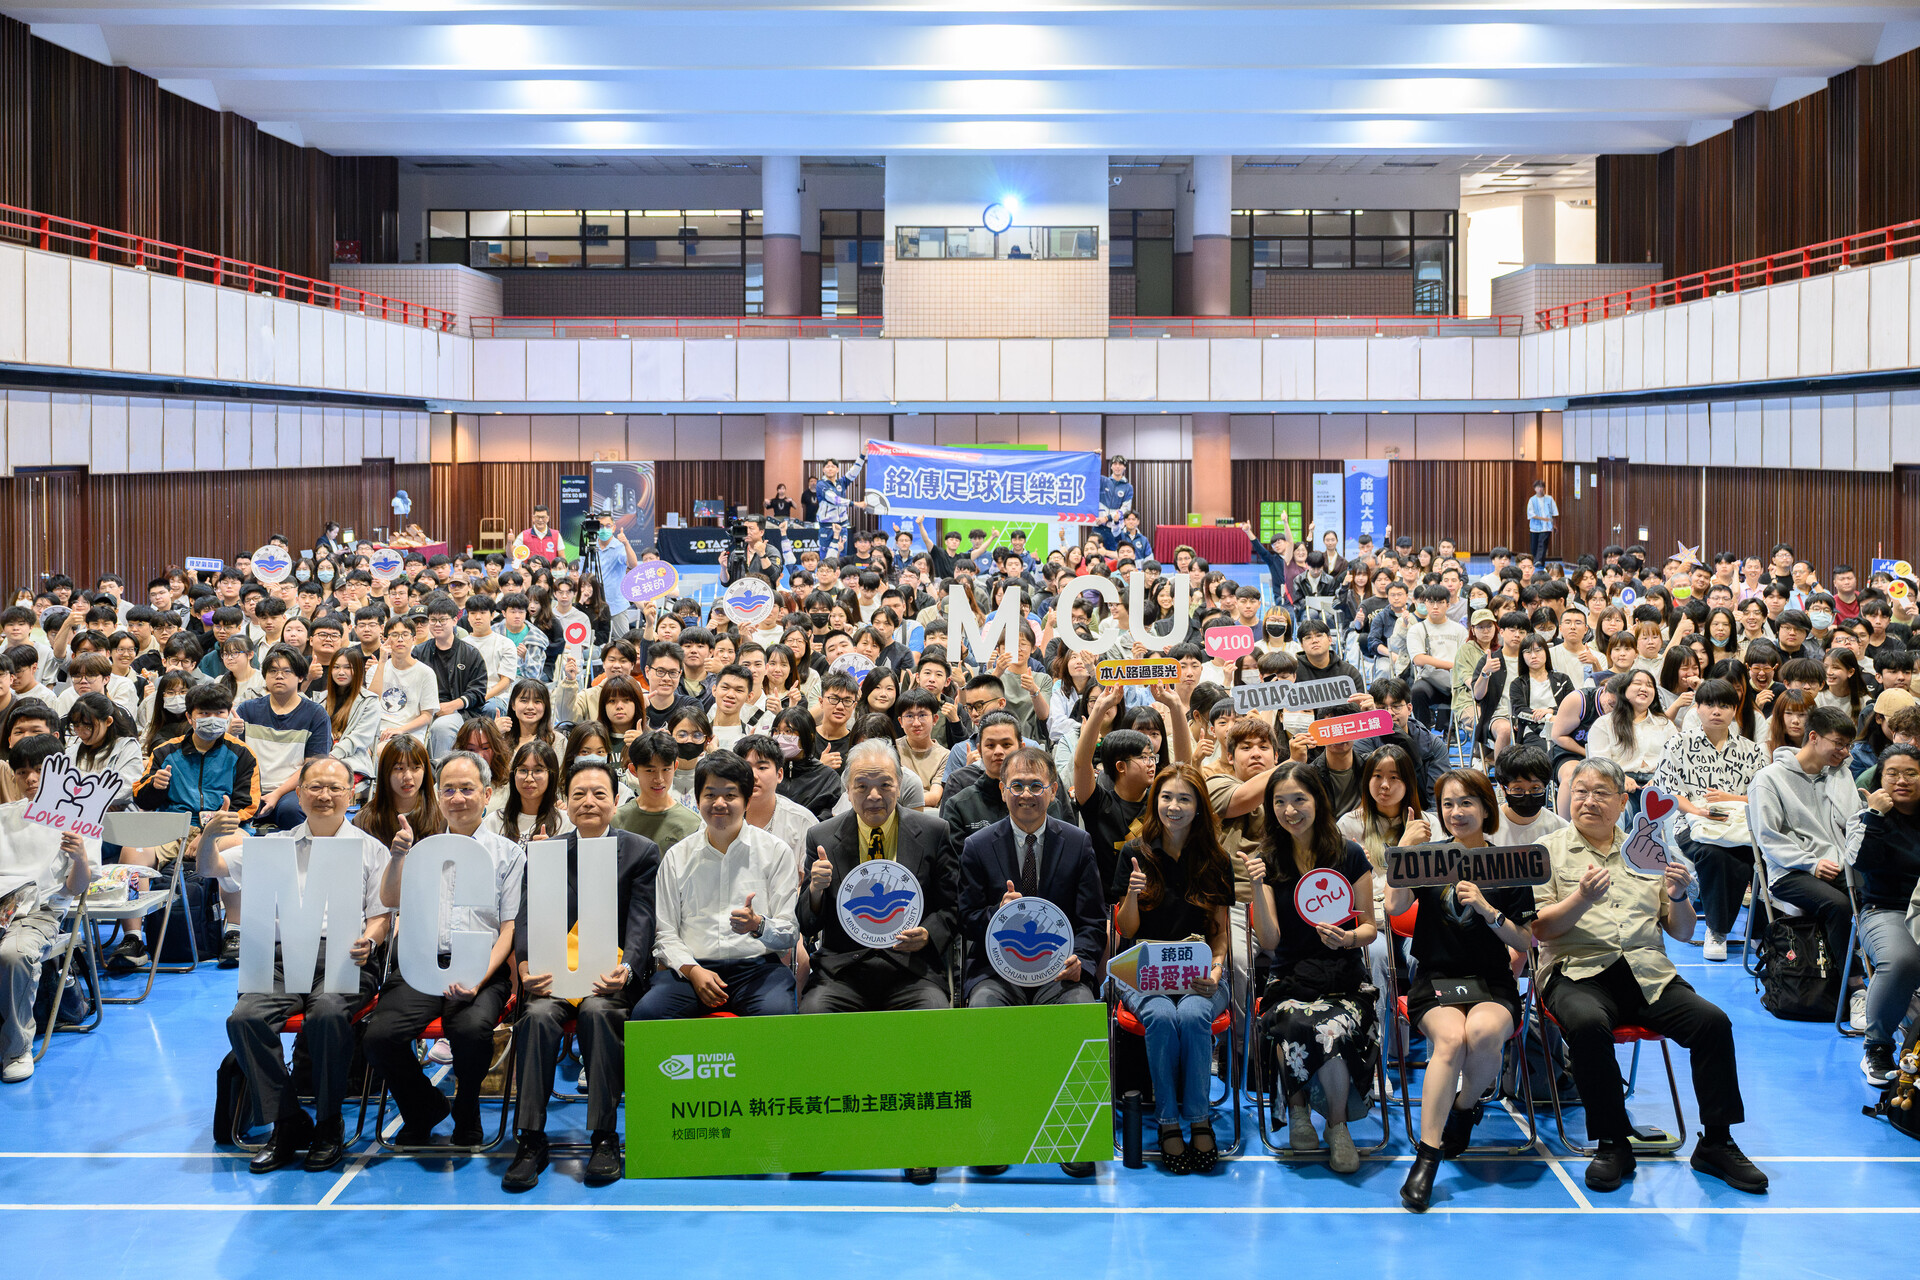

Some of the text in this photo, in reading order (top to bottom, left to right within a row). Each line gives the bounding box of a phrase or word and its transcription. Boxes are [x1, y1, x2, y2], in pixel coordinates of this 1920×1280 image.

[884, 465, 1087, 506] 銘傳足球俱樂部
[1360, 476, 1374, 535] 銘傳大學
[690, 540, 729, 550] ZOTAC
[631, 578, 665, 598] 是我的
[1223, 634, 1251, 650] 100
[1100, 664, 1178, 680] 本人路過發光
[1237, 679, 1350, 710] ZOTAC GAMING
[1318, 716, 1381, 738] 可愛已上線
[24, 803, 103, 839] Love you
[1391, 848, 1544, 882] ZOTAC GAMING
[845, 917, 859, 935] MING
[861, 932, 887, 943] CHUAN
[992, 947, 1066, 981] MING CHUAN UNIVERSITY
[1161, 946, 1193, 962] 鏡頭
[697, 1063, 736, 1079] GTC
[671, 1089, 973, 1119] NVIDIA 執行長黃仁勳主題演講直播
[672, 1126, 732, 1141] 校園同樂會
